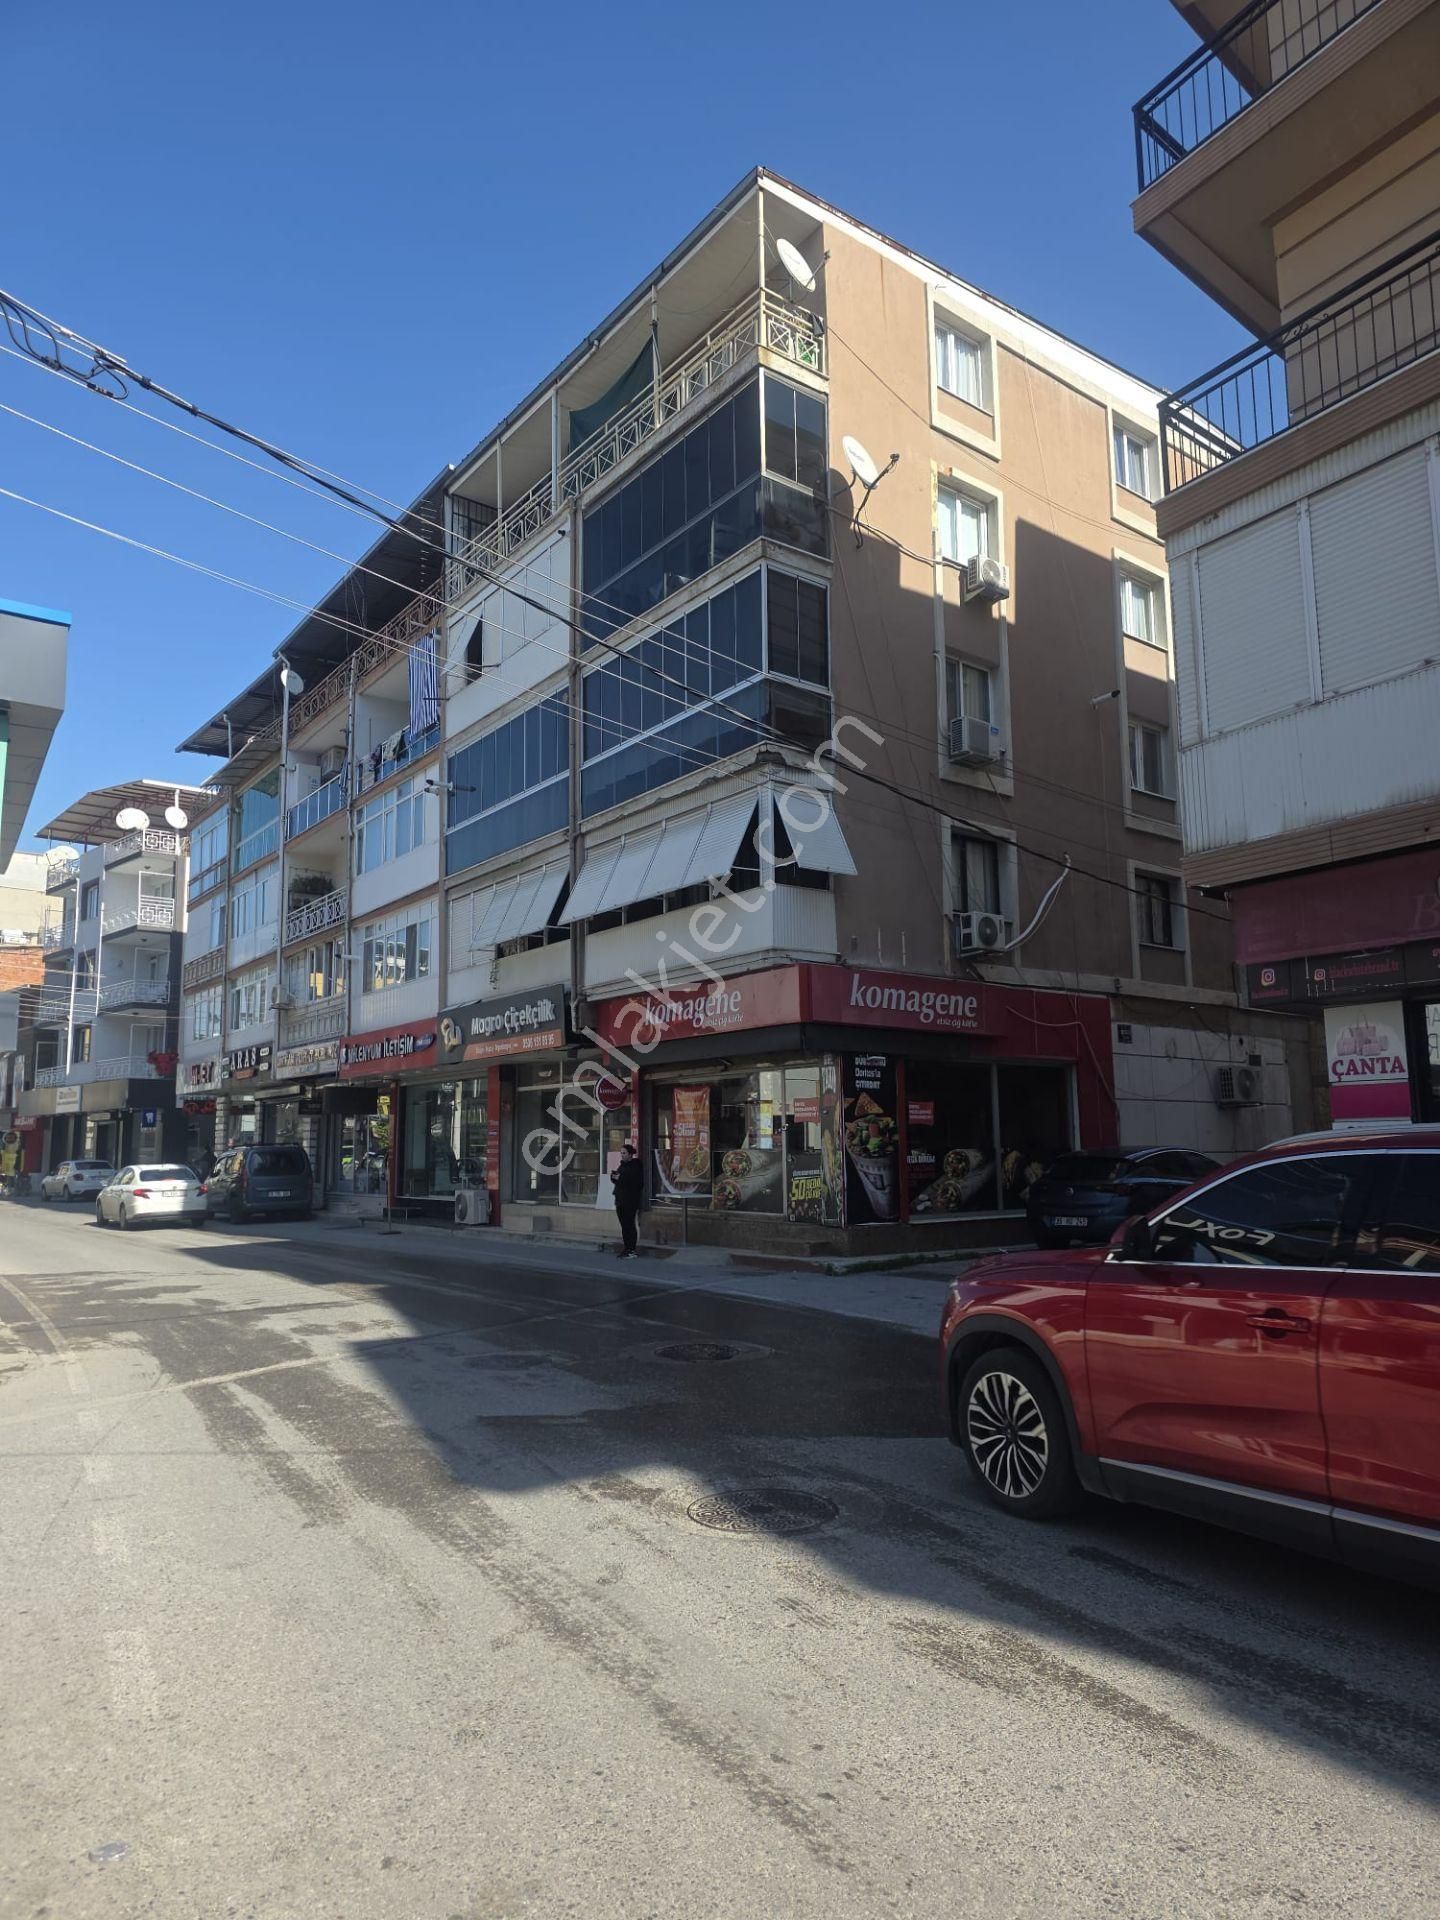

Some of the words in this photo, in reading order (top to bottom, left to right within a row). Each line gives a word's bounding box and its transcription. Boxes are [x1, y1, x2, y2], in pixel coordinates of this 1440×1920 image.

[645, 989, 742, 1028] komagene
[850, 973, 977, 1023] komagene
[471, 1012, 502, 1037] Magro
[503, 998, 556, 1035] Çiçekçilik
[231, 1046, 256, 1071] ARAS
[383, 1033, 414, 1058] İLETİŞİM
[1331, 1056, 1406, 1082] ÇANTA
